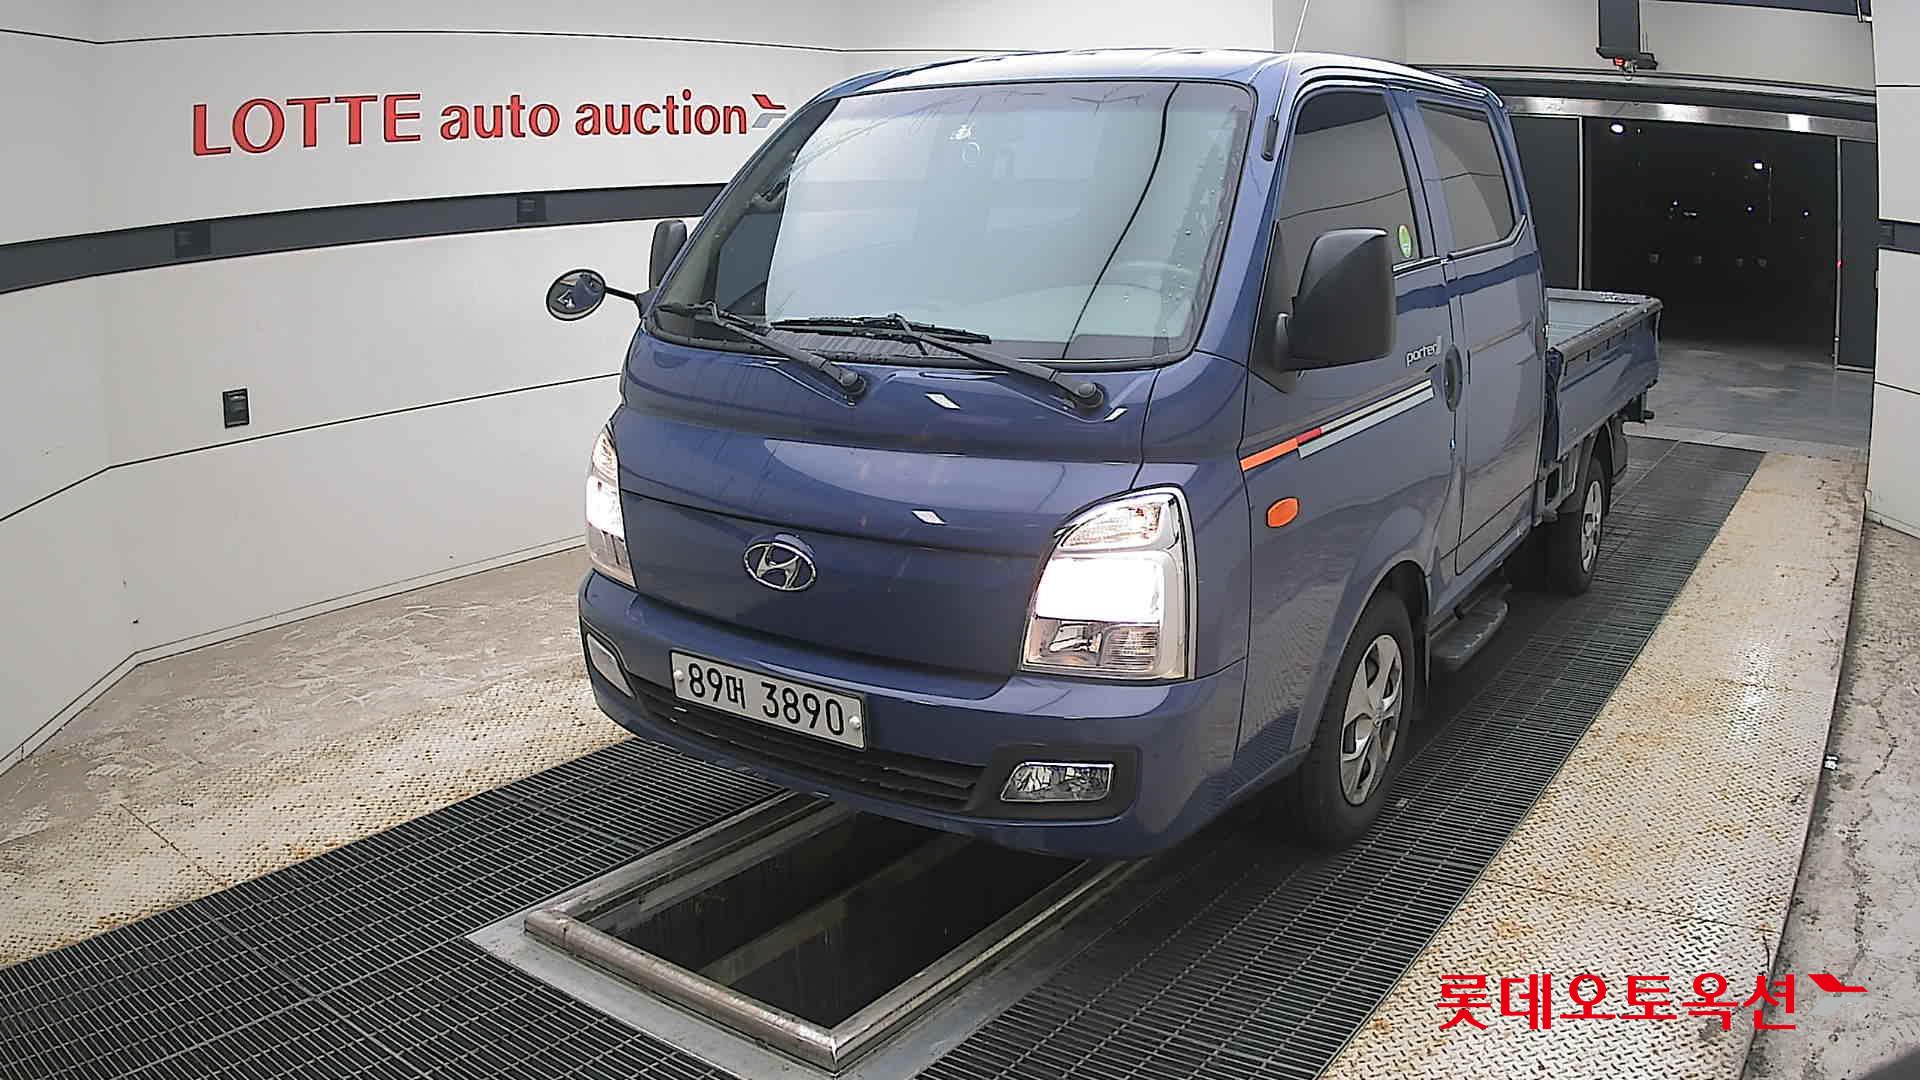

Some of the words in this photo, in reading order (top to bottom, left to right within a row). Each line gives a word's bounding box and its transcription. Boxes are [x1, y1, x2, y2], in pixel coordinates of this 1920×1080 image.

[193, 93, 421, 156] LOTTE
[440, 94, 560, 141] auto
[575, 89, 748, 136] auction
[688, 663, 747, 709] 89머
[760, 682, 844, 736] 3890
